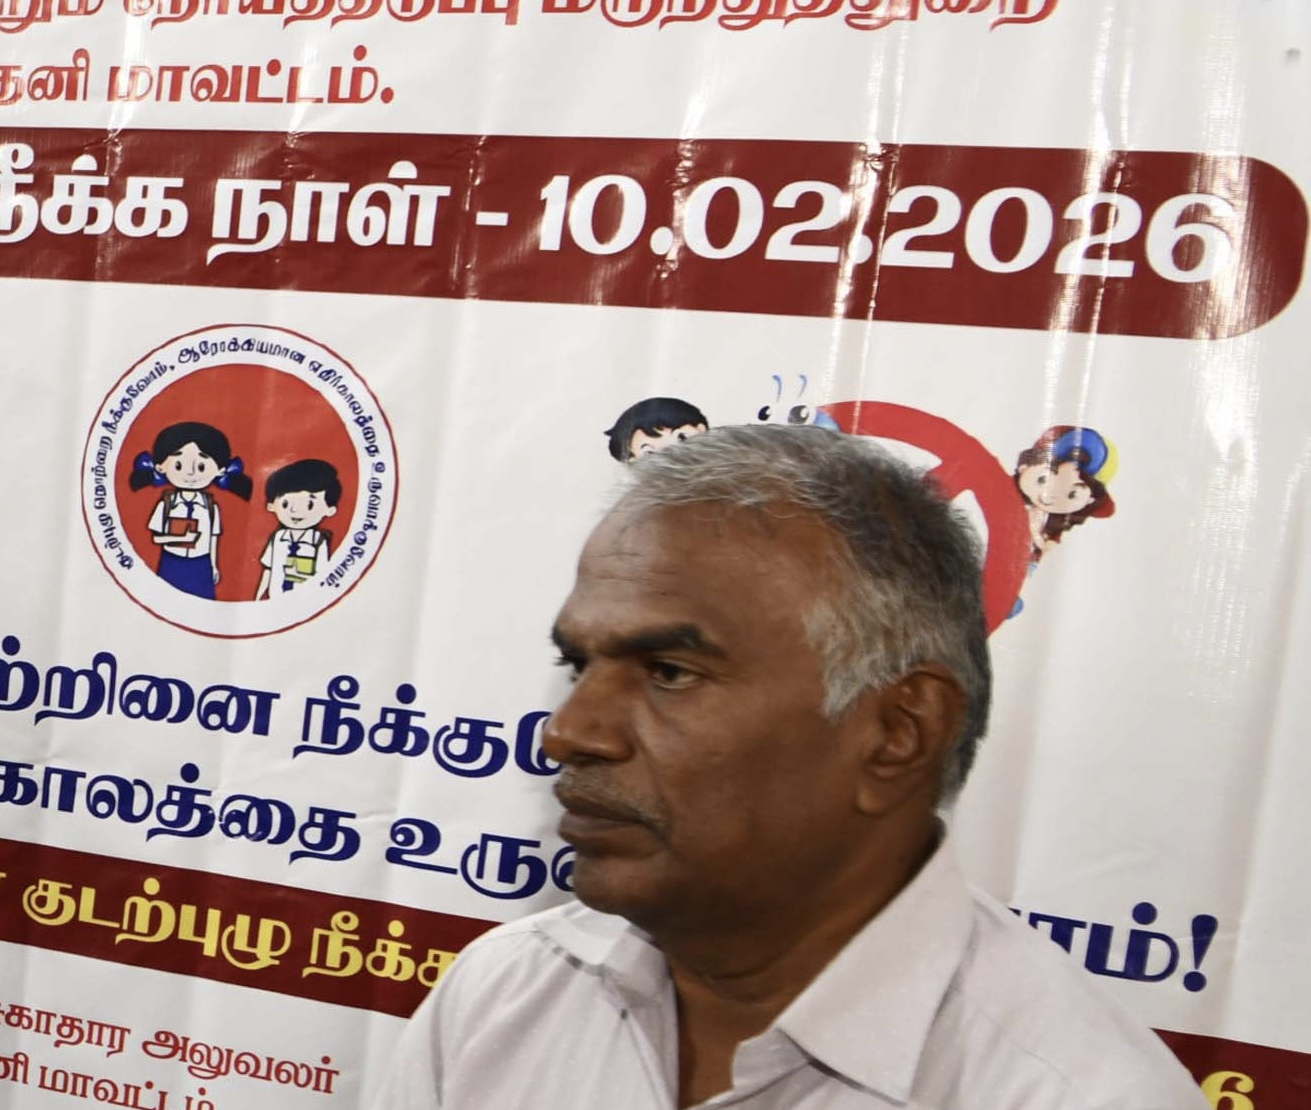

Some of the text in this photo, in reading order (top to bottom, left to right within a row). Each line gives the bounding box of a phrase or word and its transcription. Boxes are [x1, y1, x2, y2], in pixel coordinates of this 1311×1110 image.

[106, 44, 395, 104] மாவட்டம்.
[206, 160, 451, 266] நாள்
[539, 173, 1237, 282] 10.02.2026
[22, 876, 291, 970] குடற்புழு
[141, 1026, 340, 1094] அலுவலர்
